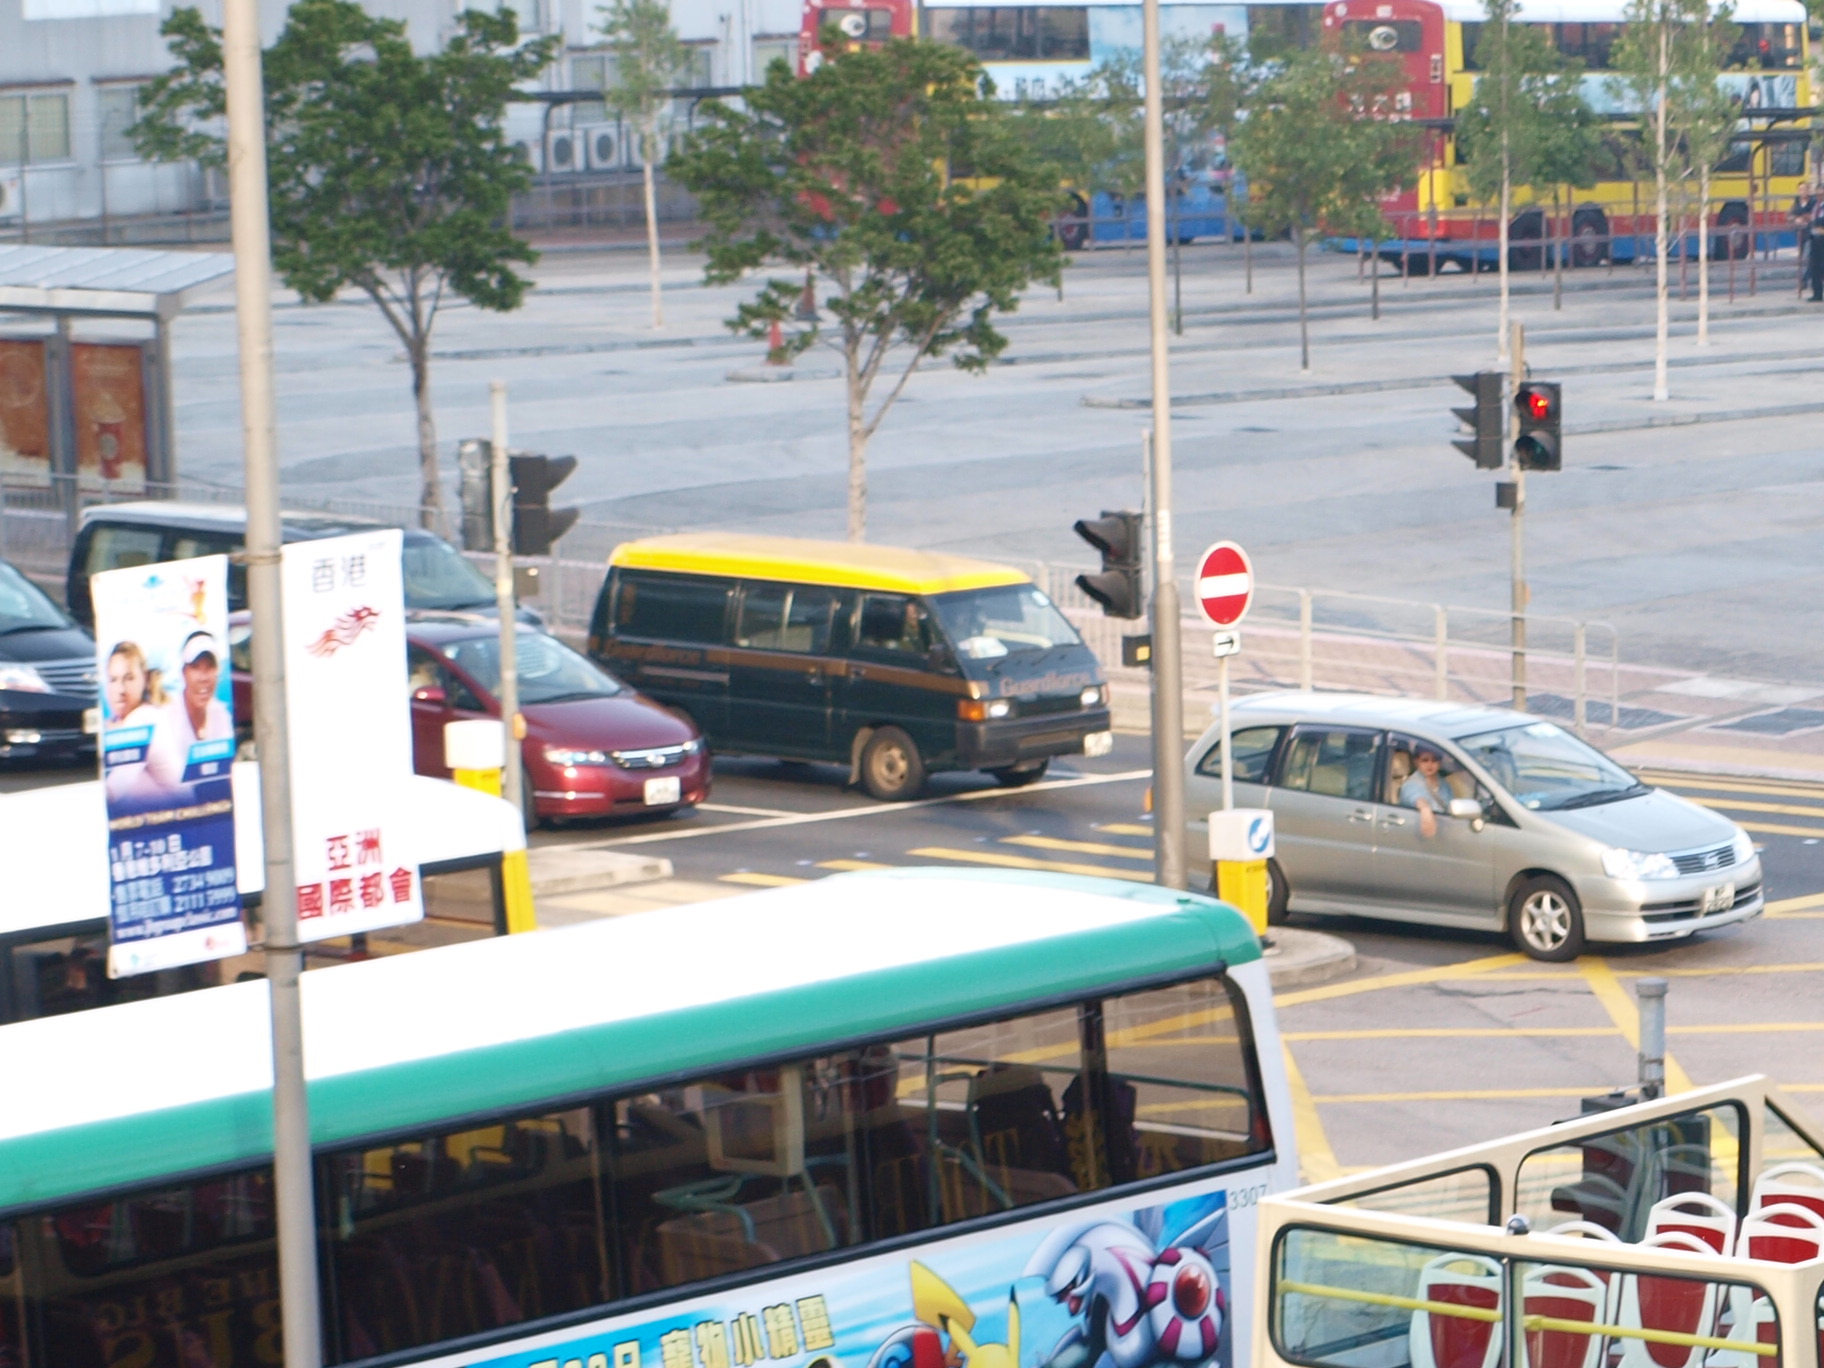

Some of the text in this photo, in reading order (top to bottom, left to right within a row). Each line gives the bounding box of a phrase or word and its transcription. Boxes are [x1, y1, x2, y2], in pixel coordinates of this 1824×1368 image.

[312, 554, 367, 593] 香港
[326, 827, 382, 871] 亞洲
[295, 866, 413, 921] 國際都會
